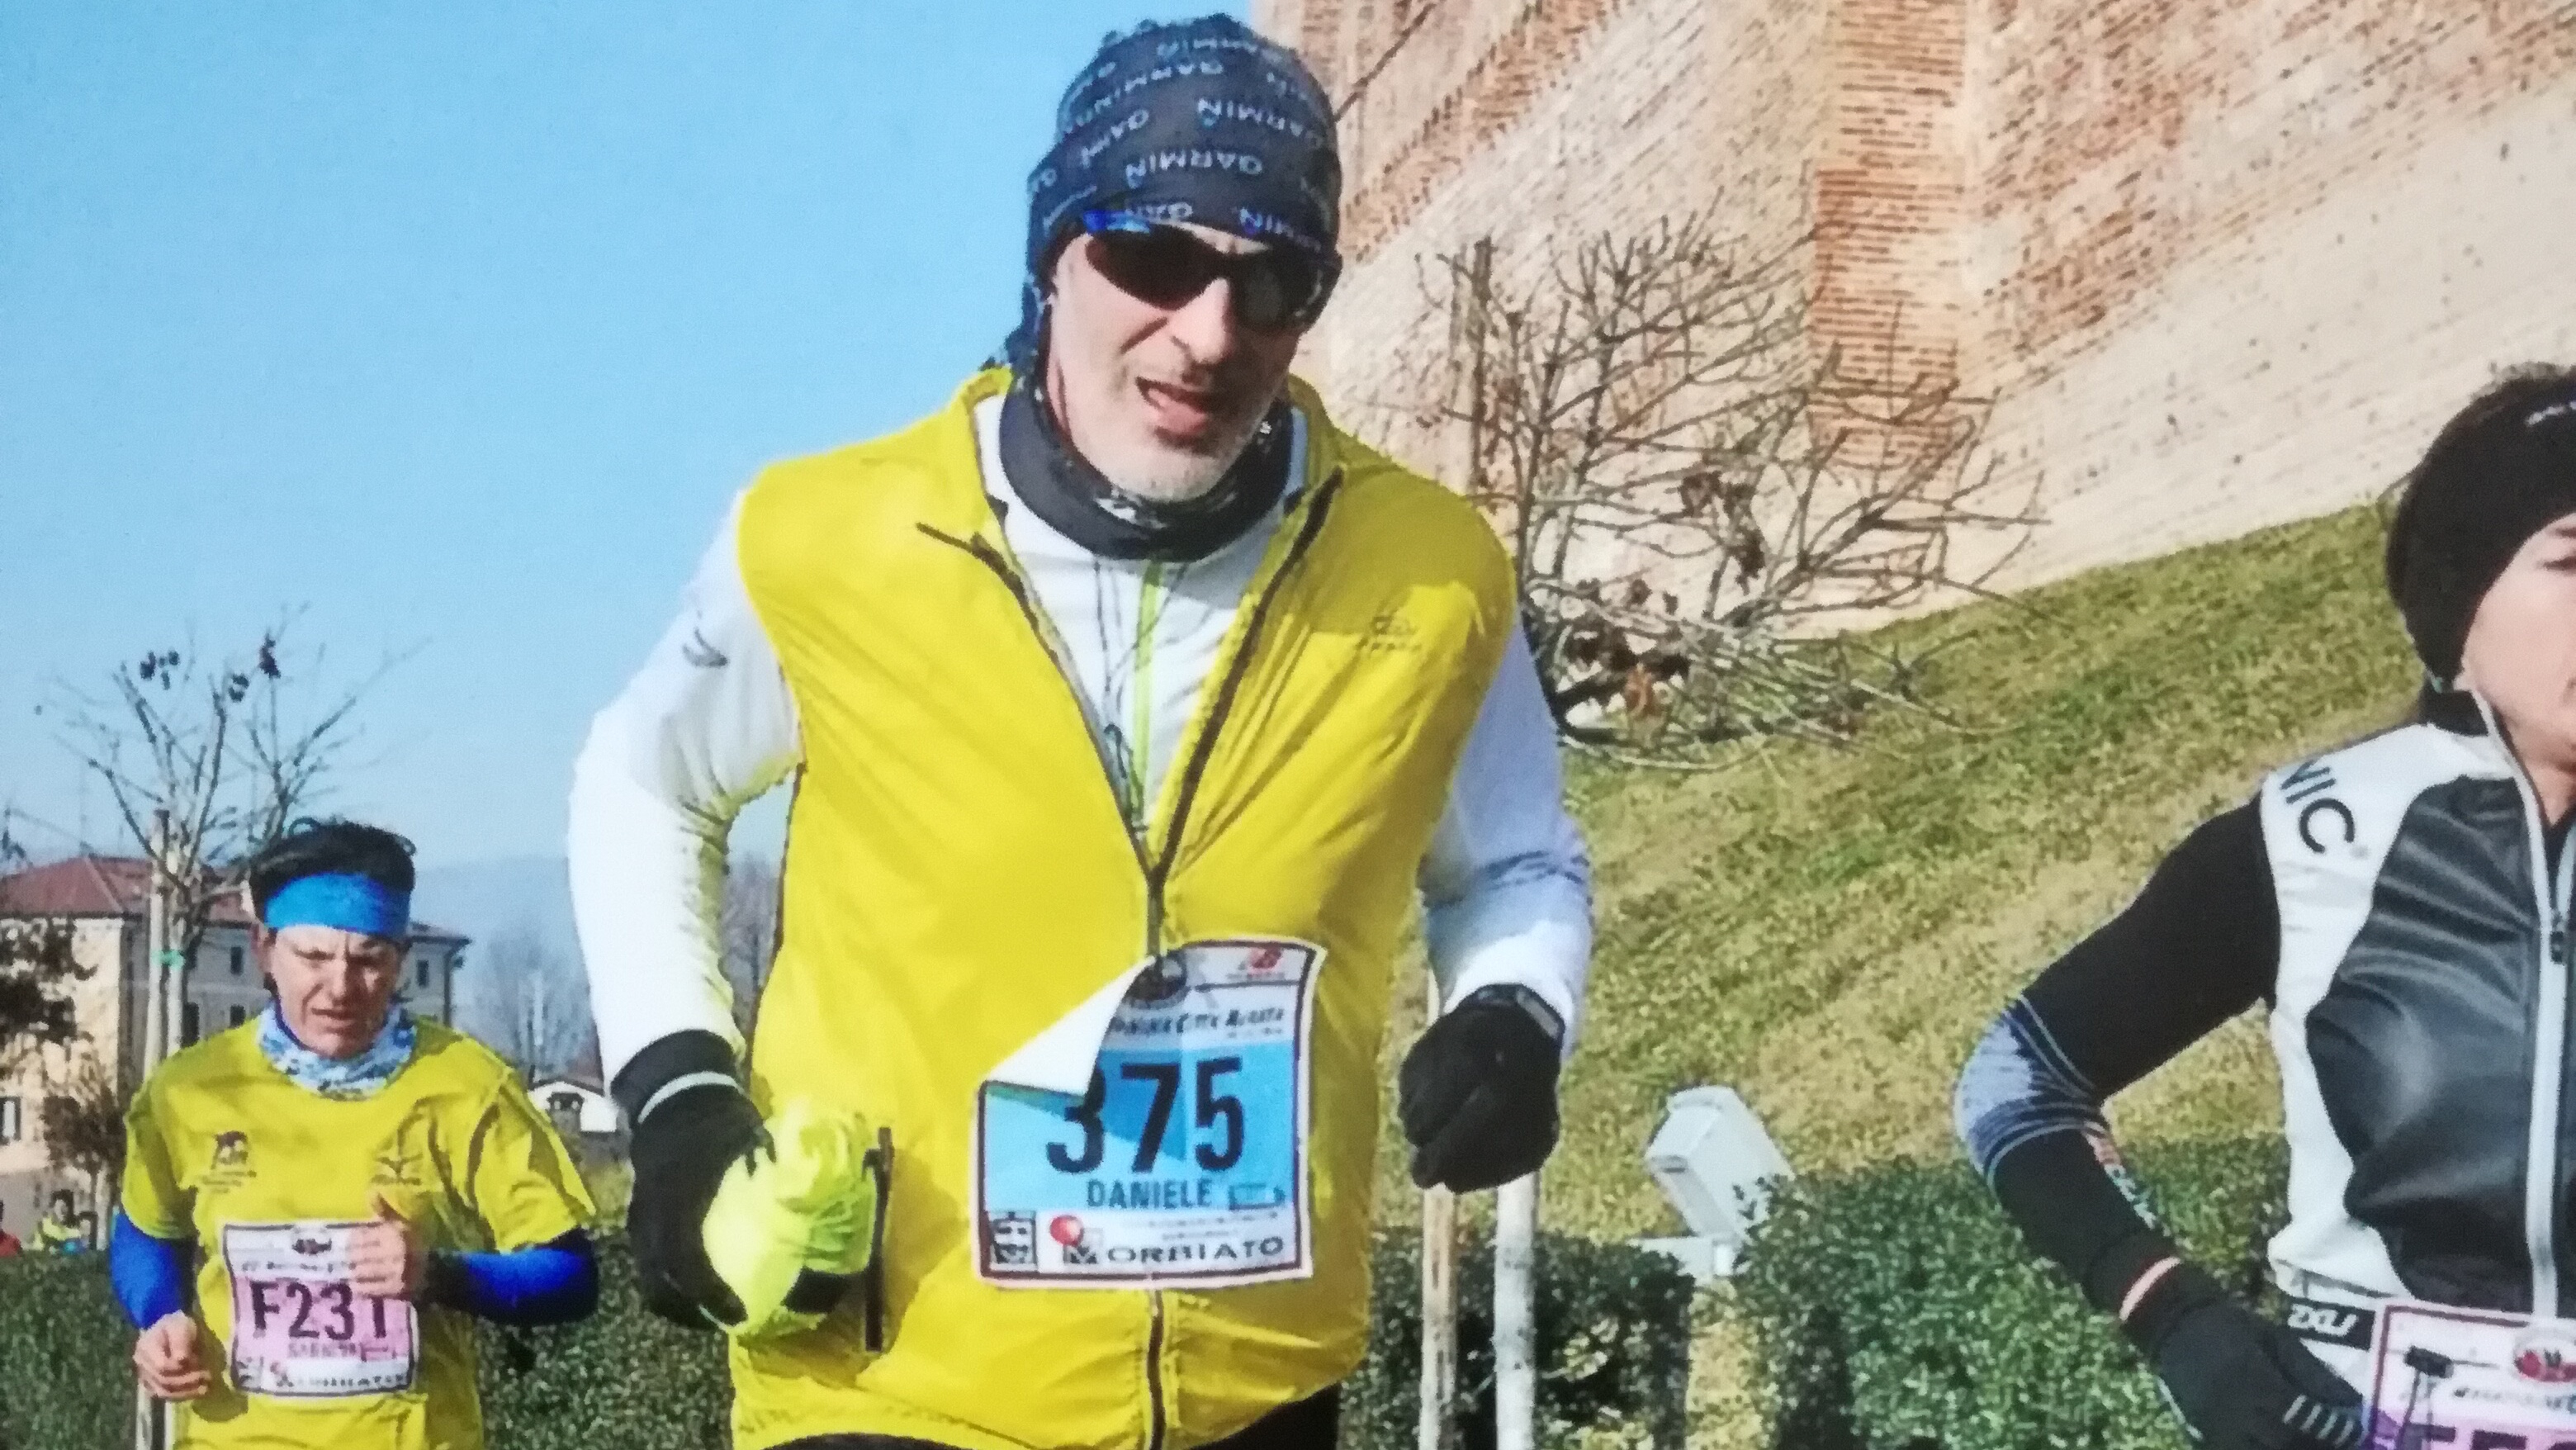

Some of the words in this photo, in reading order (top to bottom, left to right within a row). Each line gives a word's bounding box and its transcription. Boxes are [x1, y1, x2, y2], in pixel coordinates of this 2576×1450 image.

[1125, 149, 1262, 189] GARMIN
[1046, 1055, 1244, 1173] 375
[1087, 1178, 1214, 1209] DANIELE
